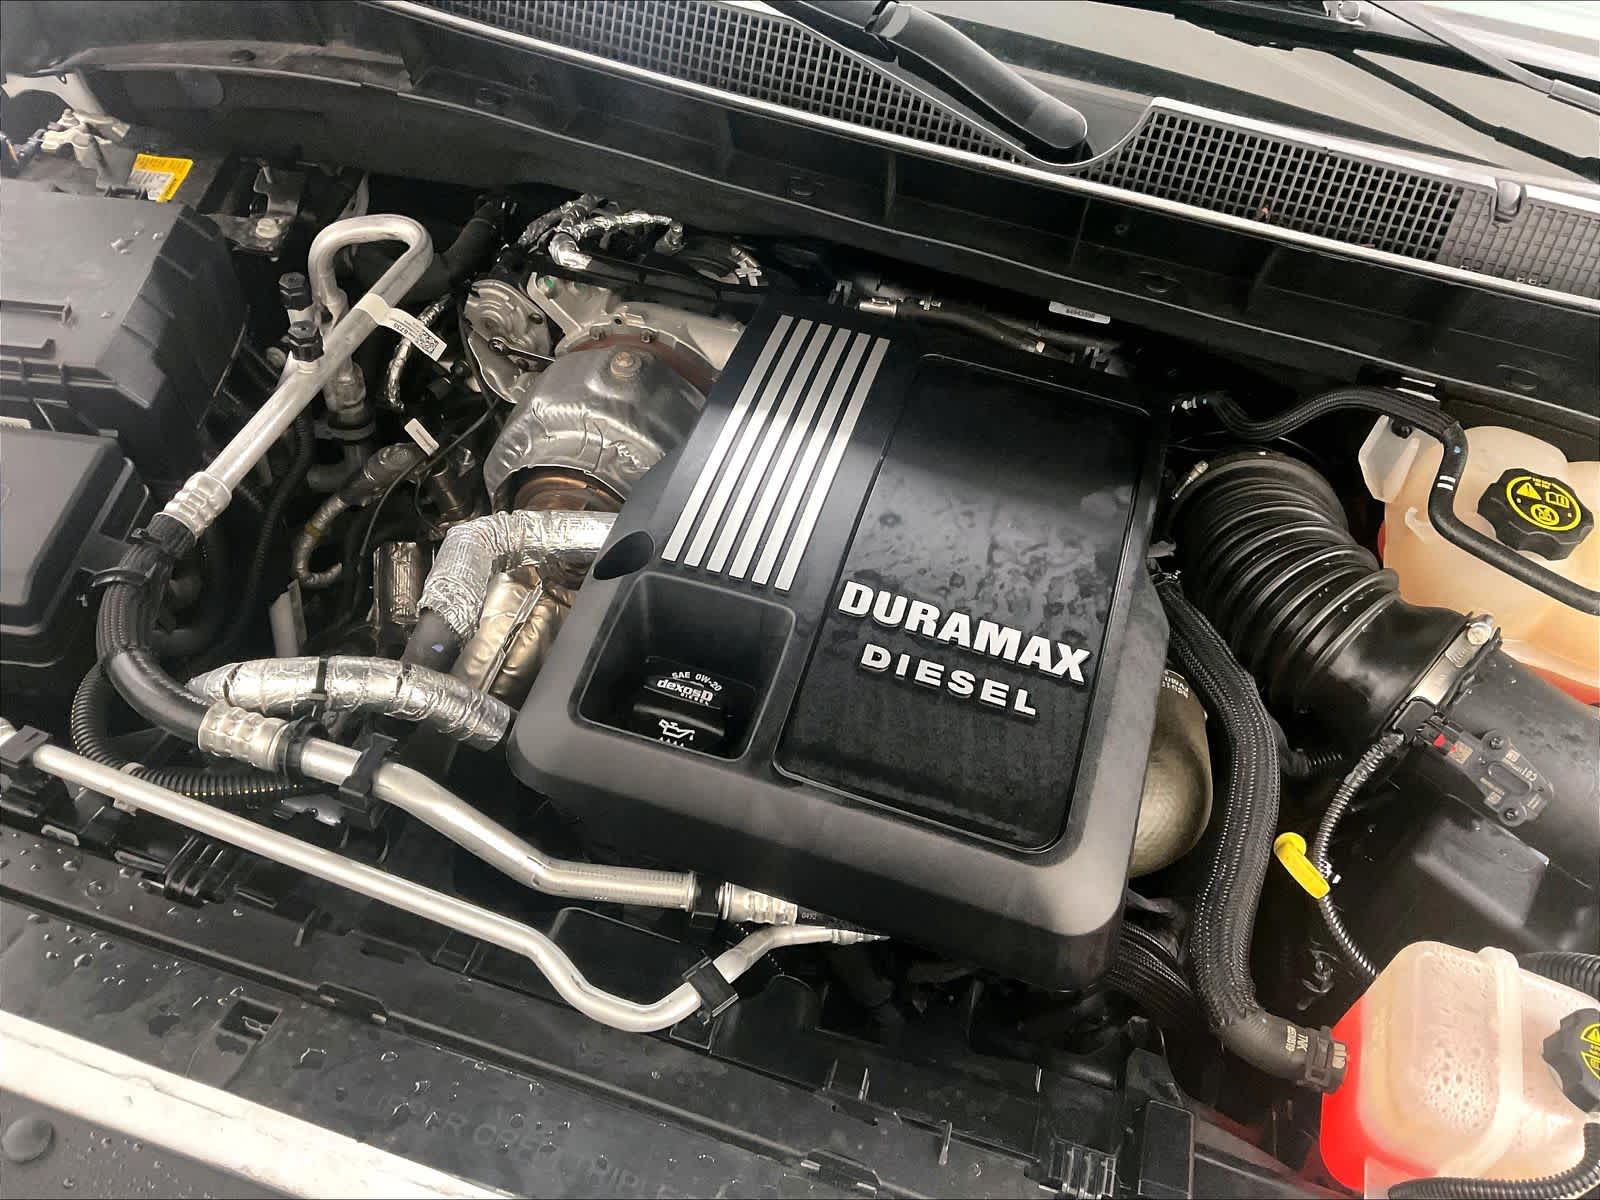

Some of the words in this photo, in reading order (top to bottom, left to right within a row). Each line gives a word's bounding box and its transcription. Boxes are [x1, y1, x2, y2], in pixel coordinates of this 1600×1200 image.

[838, 580, 1090, 686] DURAMAX
[672, 671, 691, 680] SAE
[695, 673, 722, 691] 0W-20
[861, 643, 1036, 718] DIESEL
